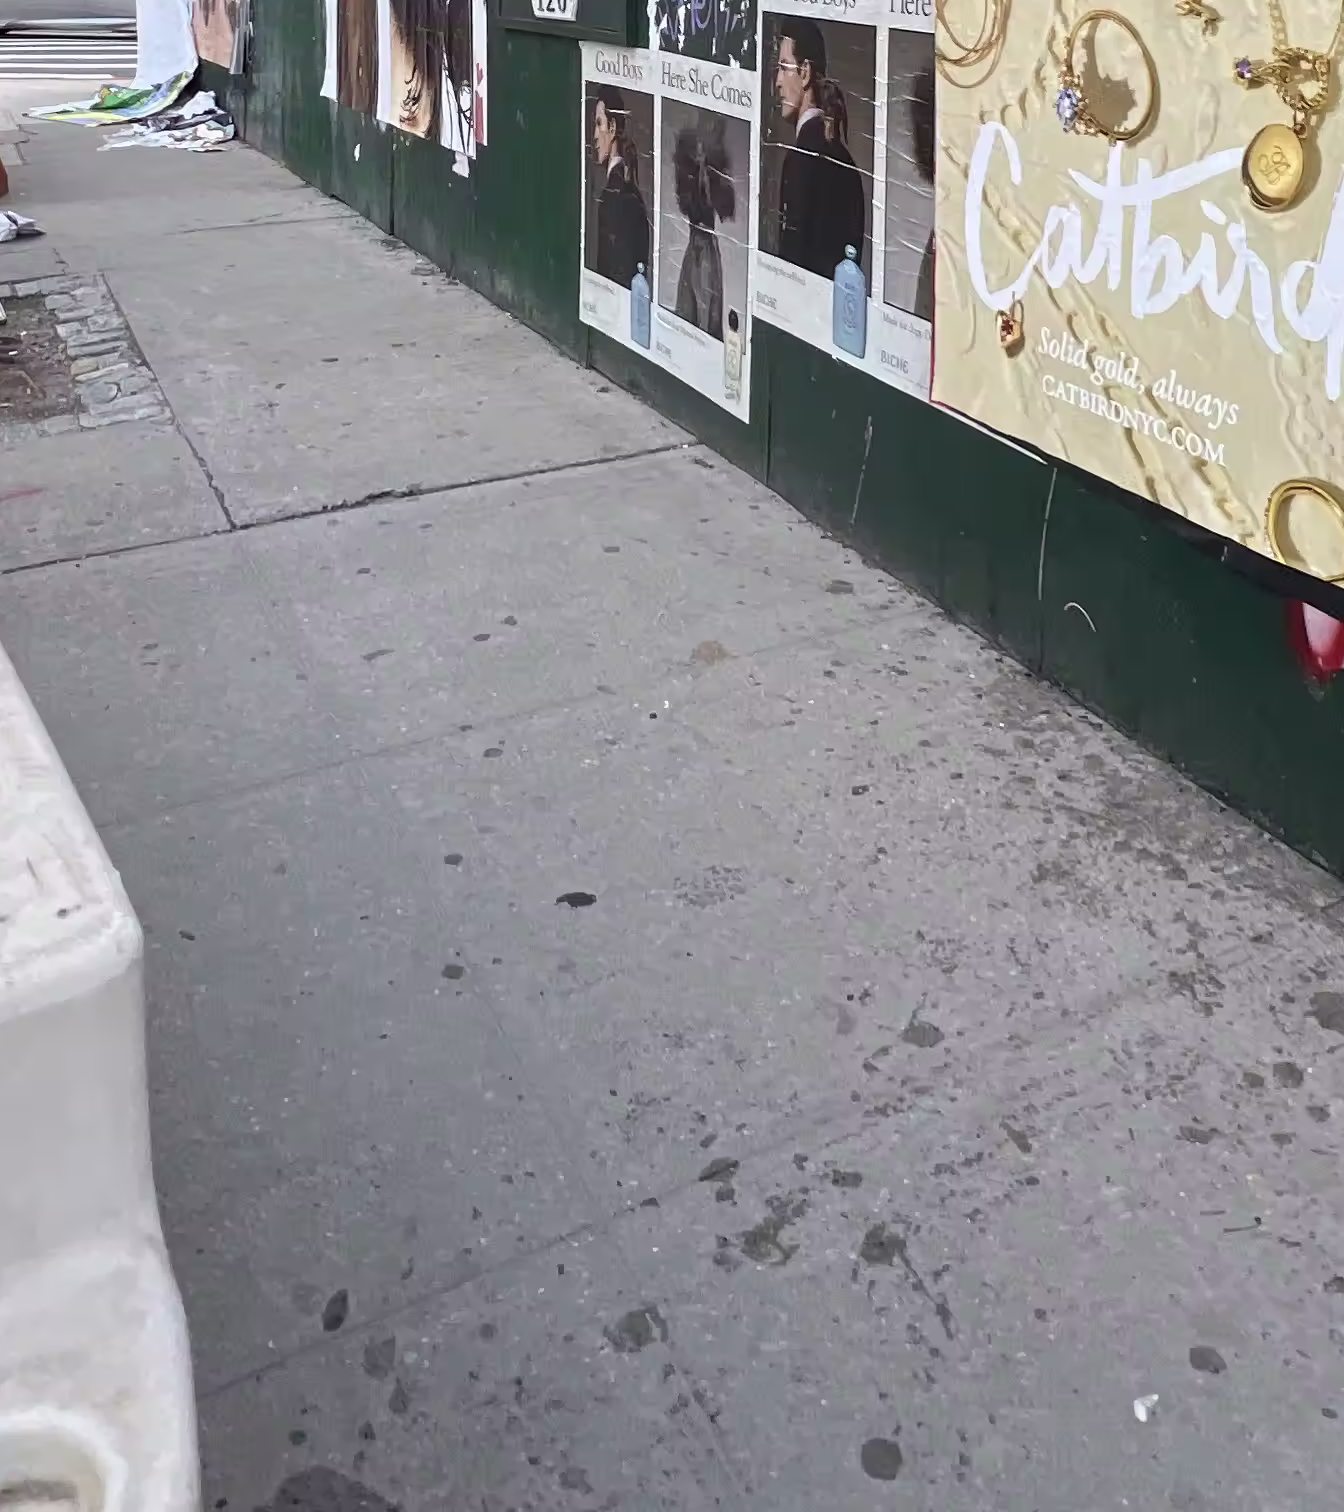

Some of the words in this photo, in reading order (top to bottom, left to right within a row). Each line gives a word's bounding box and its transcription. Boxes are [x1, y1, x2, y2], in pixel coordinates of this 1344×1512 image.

[595, 50, 621, 75] Good
[622, 54, 643, 85] Boys
[661, 61, 687, 91] Here
[688, 68, 709, 97] She
[711, 73, 753, 109] Comes
[1037, 326, 1089, 370] Solid
[1090, 351, 1146, 395] gold,
[1152, 369, 1240, 431] always
[1042, 374, 1225, 467] CATBIRDNYC.COM
